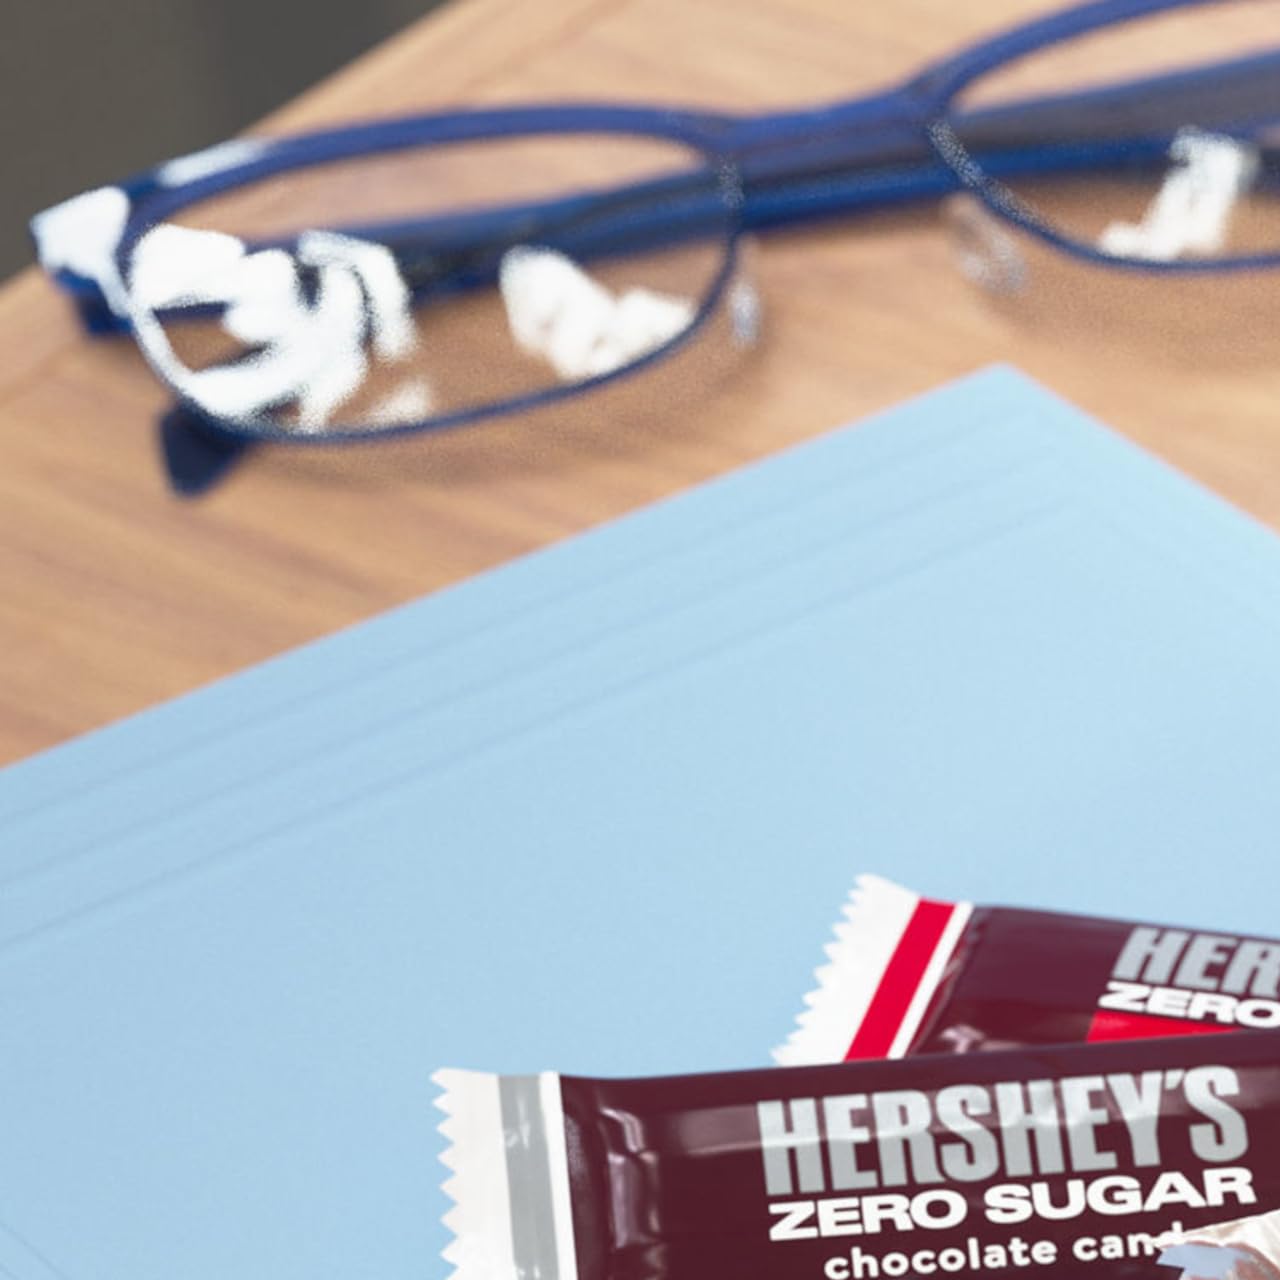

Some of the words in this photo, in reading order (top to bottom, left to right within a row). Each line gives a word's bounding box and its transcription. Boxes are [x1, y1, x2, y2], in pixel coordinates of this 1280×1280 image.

[757, 1066, 1249, 1196] HERSHEY'S
[769, 1191, 968, 1241] ZERO
[984, 1167, 1257, 1225] SUGAR
